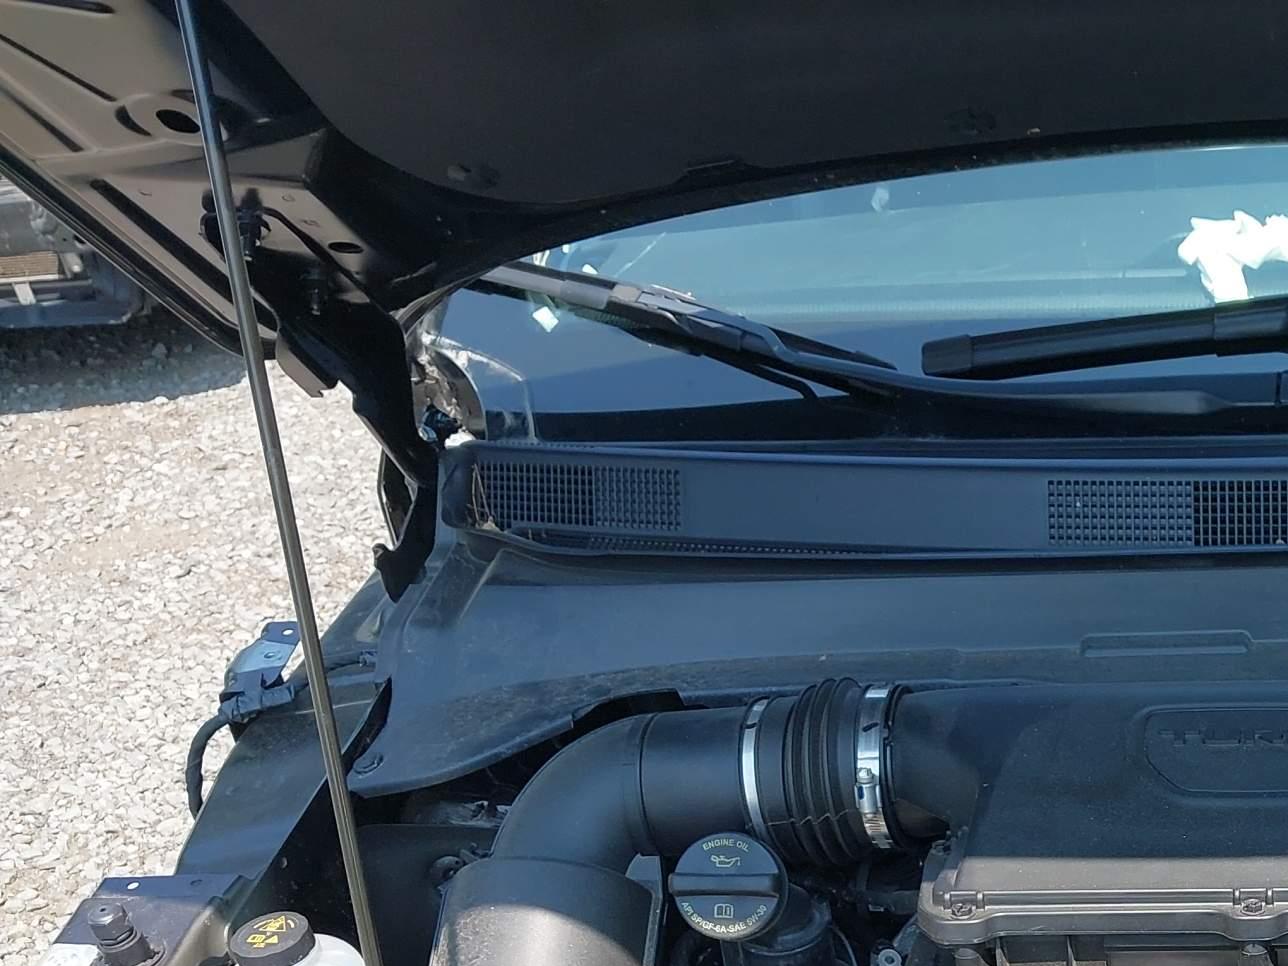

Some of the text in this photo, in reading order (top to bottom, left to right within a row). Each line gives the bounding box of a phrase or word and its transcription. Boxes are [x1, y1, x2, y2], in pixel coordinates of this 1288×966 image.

[702, 839, 750, 852] ENGINE OIL
[681, 902, 693, 916] API
